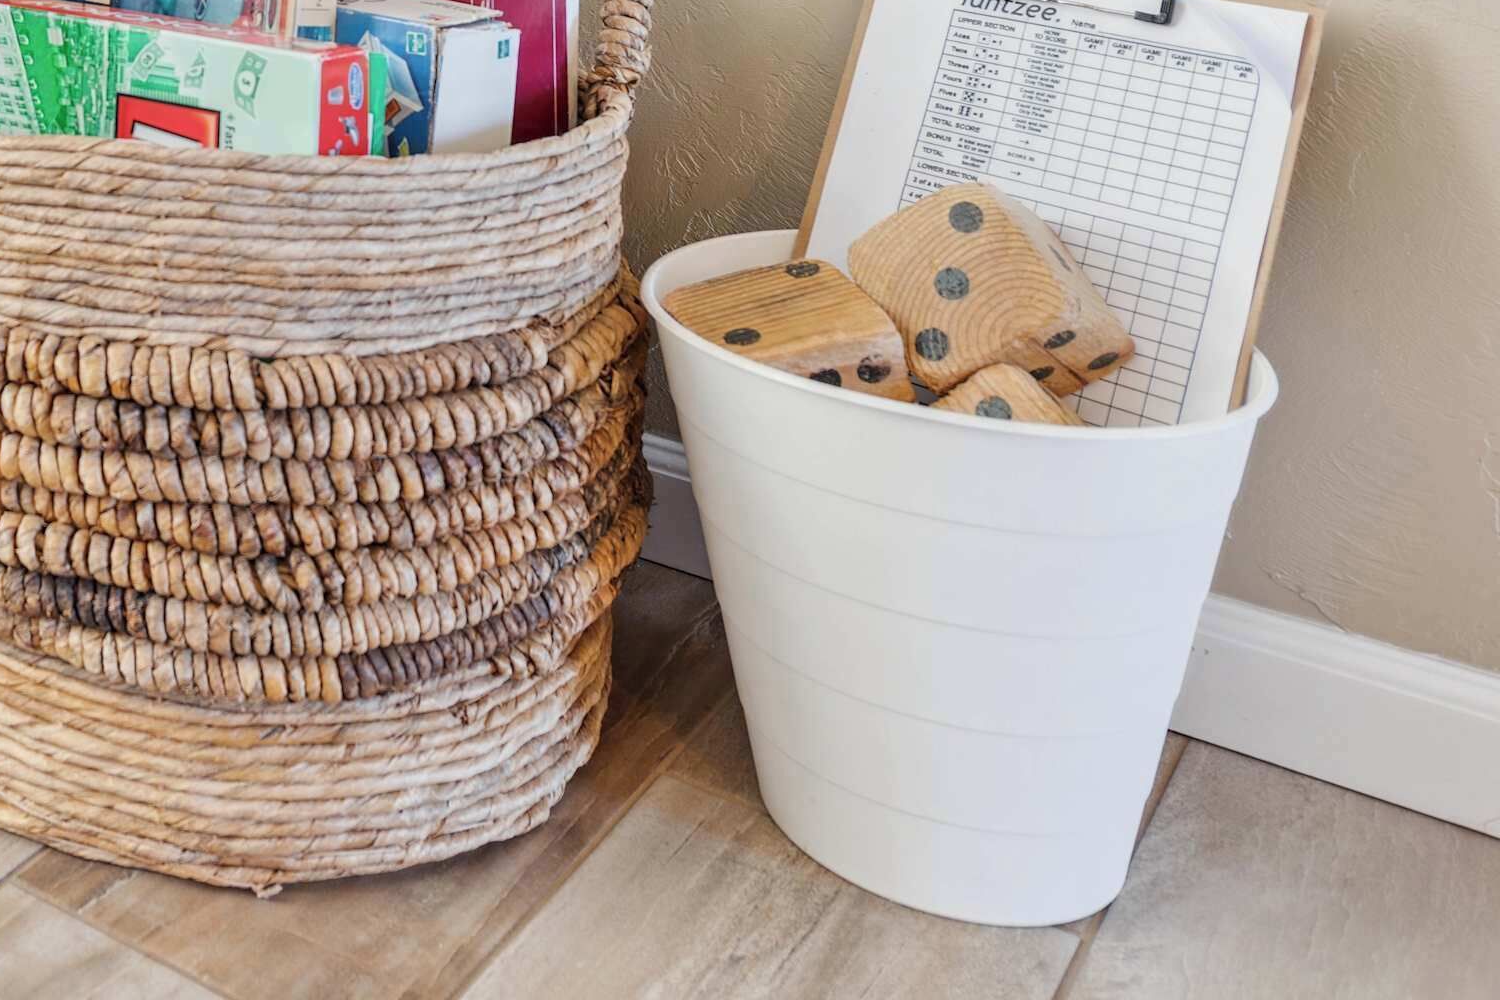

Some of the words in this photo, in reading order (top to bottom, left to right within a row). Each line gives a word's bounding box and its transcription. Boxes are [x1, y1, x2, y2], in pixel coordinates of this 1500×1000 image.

[957, 16, 981, 28] UPPER
[983, 21, 1016, 33] SECTION
[1071, 19, 1096, 30] Name
[952, 31, 971, 40] Aces
[1044, 35, 1068, 44] SCORE
[1084, 37, 1104, 45] GAME
[1112, 42, 1132, 51] GAME
[1141, 47, 1162, 56] GAME
[1171, 53, 1192, 62] GAME
[947, 60, 970, 70] Threes
[1201, 59, 1222, 68] GAME
[1234, 65, 1253, 74] GAME
[942, 74, 962, 83] Fours
[938, 88, 957, 97] Fives
[934, 102, 953, 112] Sixes
[931, 116, 953, 128] TOTAL
[955, 122, 981, 133] SCORE
[926, 131, 952, 142] BONUS
[922, 146, 945, 158] TOTAL
[917, 162, 944, 173] LOWER
[946, 169, 979, 183] SECTION
